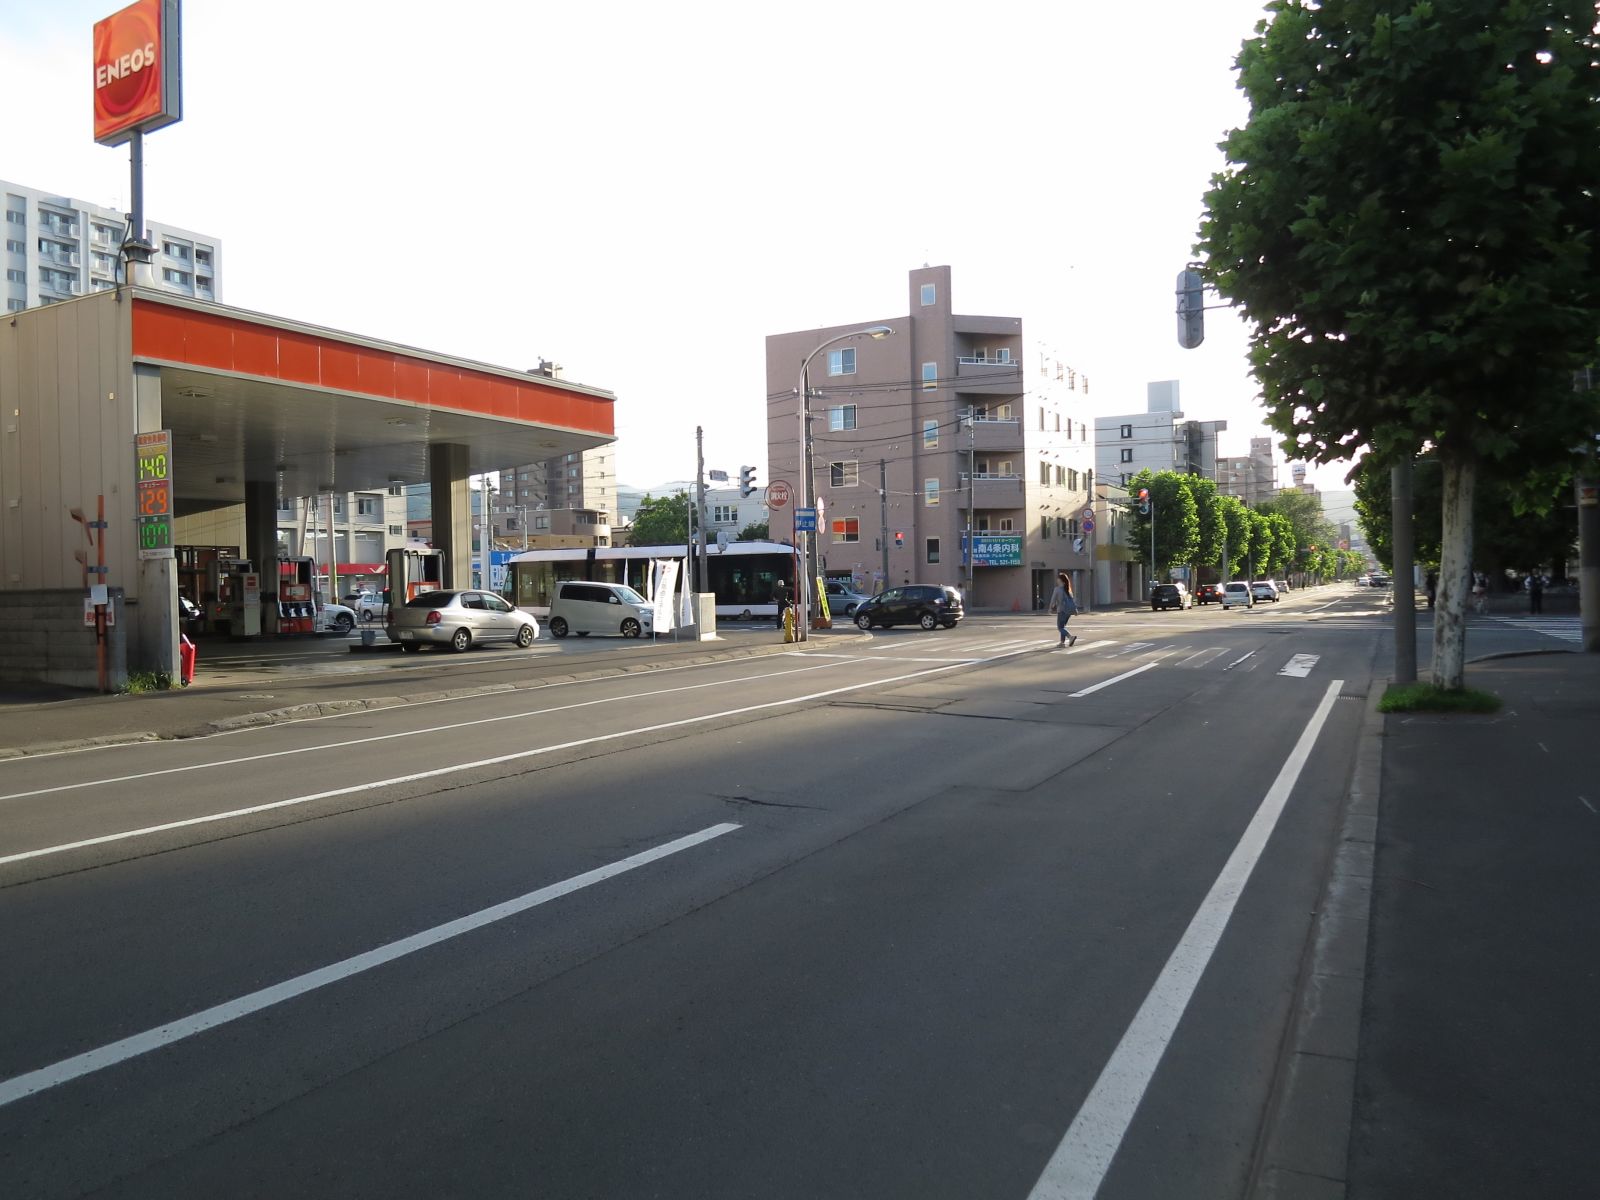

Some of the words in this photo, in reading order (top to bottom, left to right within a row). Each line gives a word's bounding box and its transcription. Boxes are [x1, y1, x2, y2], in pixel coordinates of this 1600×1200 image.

[96, 42, 154, 89] ENEOS
[139, 454, 166, 480] 140
[139, 489, 168, 514] 129
[142, 523, 168, 549] 107
[977, 543, 1020, 554] 南4条内科
